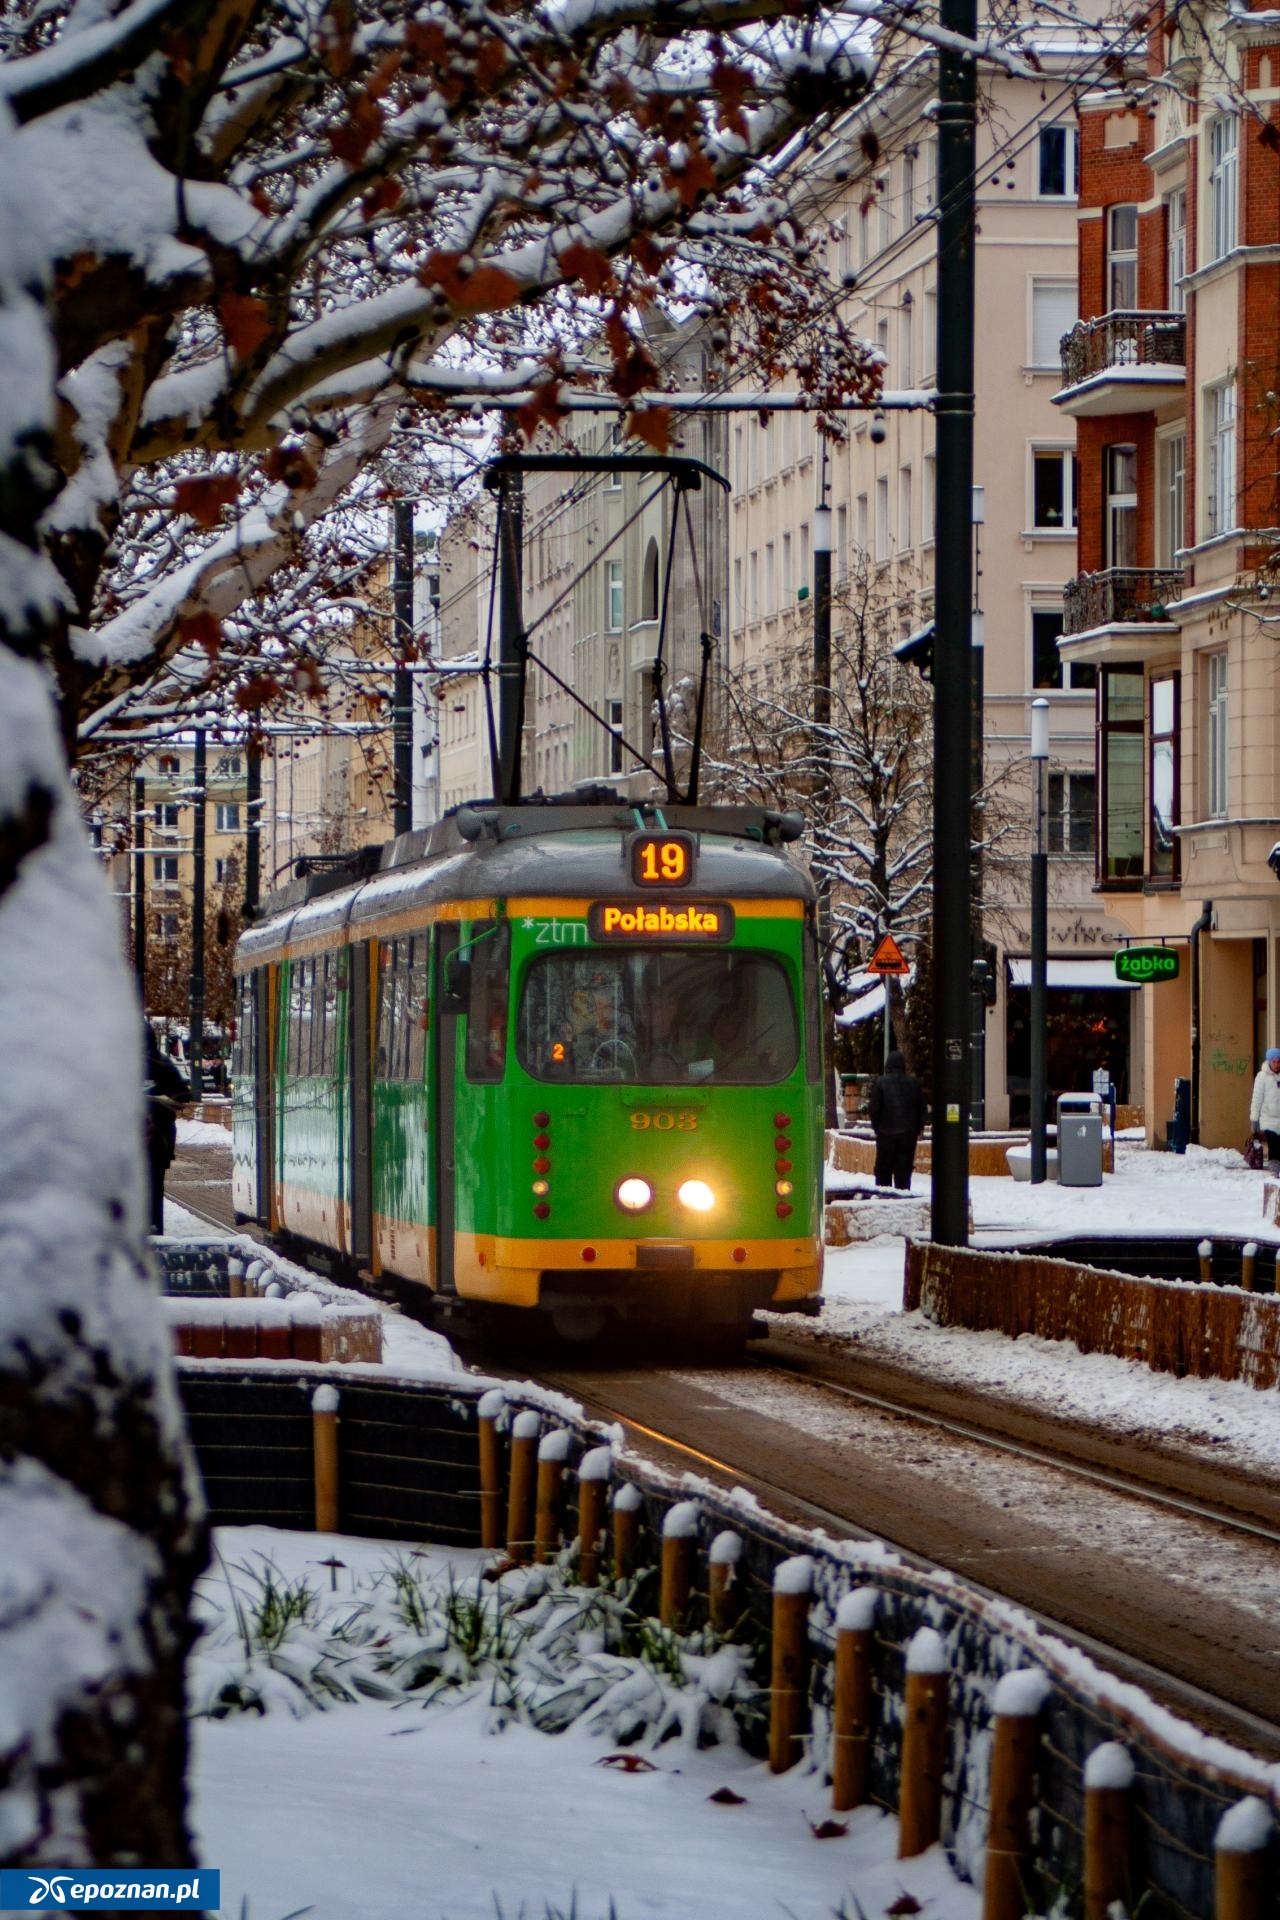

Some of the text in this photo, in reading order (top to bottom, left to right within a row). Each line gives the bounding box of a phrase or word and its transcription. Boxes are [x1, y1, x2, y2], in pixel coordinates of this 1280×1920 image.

[641, 842, 685, 881] 19
[534, 916, 588, 944] ztm
[603, 905, 719, 933] Połabska
[1120, 955, 1175, 972] żabka
[552, 1043, 565, 1061] 2
[629, 1111, 698, 1131] 903
